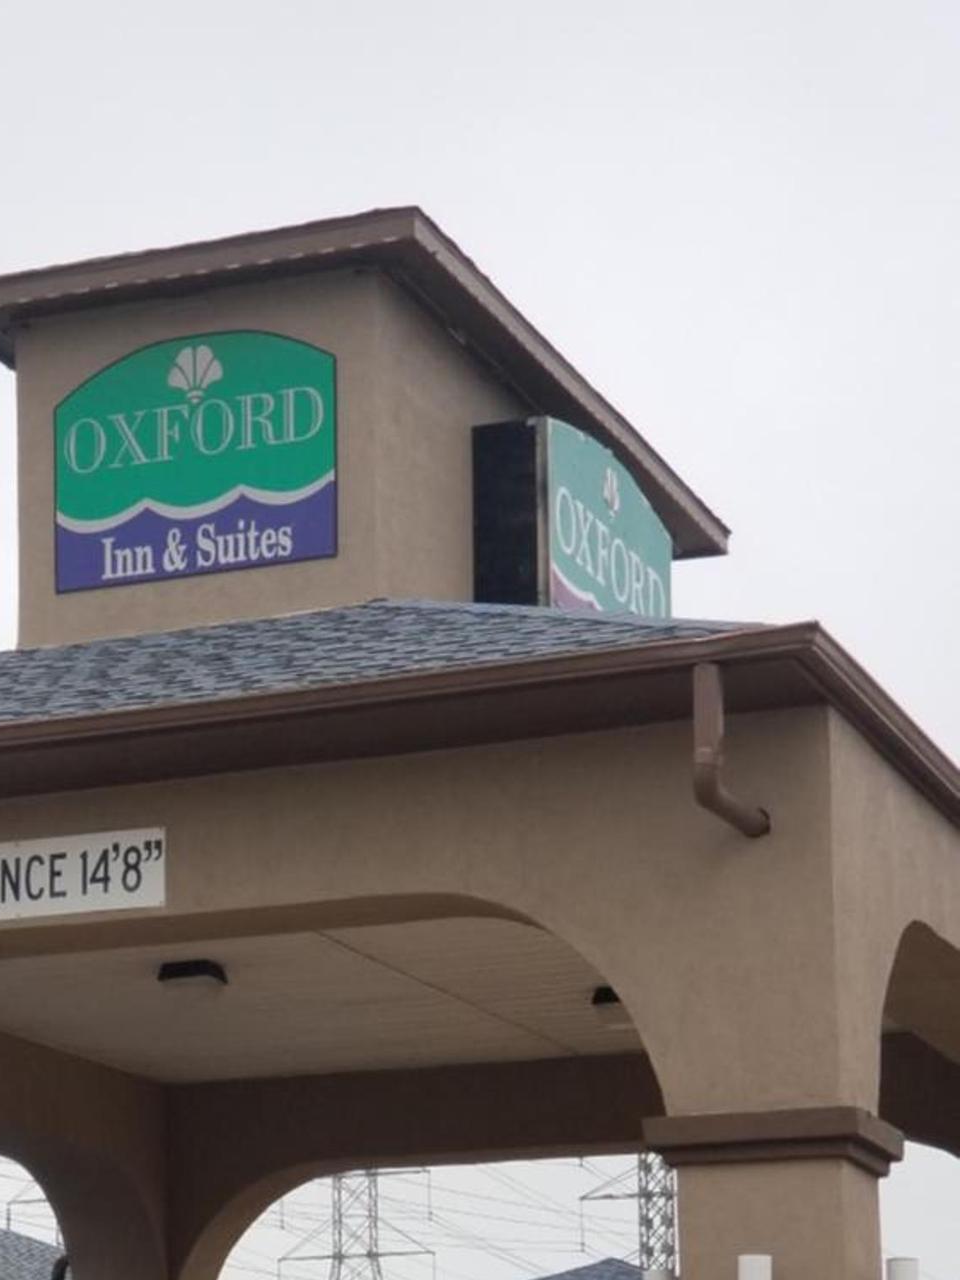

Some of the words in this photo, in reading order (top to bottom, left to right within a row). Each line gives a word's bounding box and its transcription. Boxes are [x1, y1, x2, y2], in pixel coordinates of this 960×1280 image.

[63, 386, 325, 474] OXFORD
[101, 537, 156, 580] Inn
[163, 527, 188, 572] &
[196, 519, 294, 568] Suites
[555, 486, 667, 618] OXFORD
